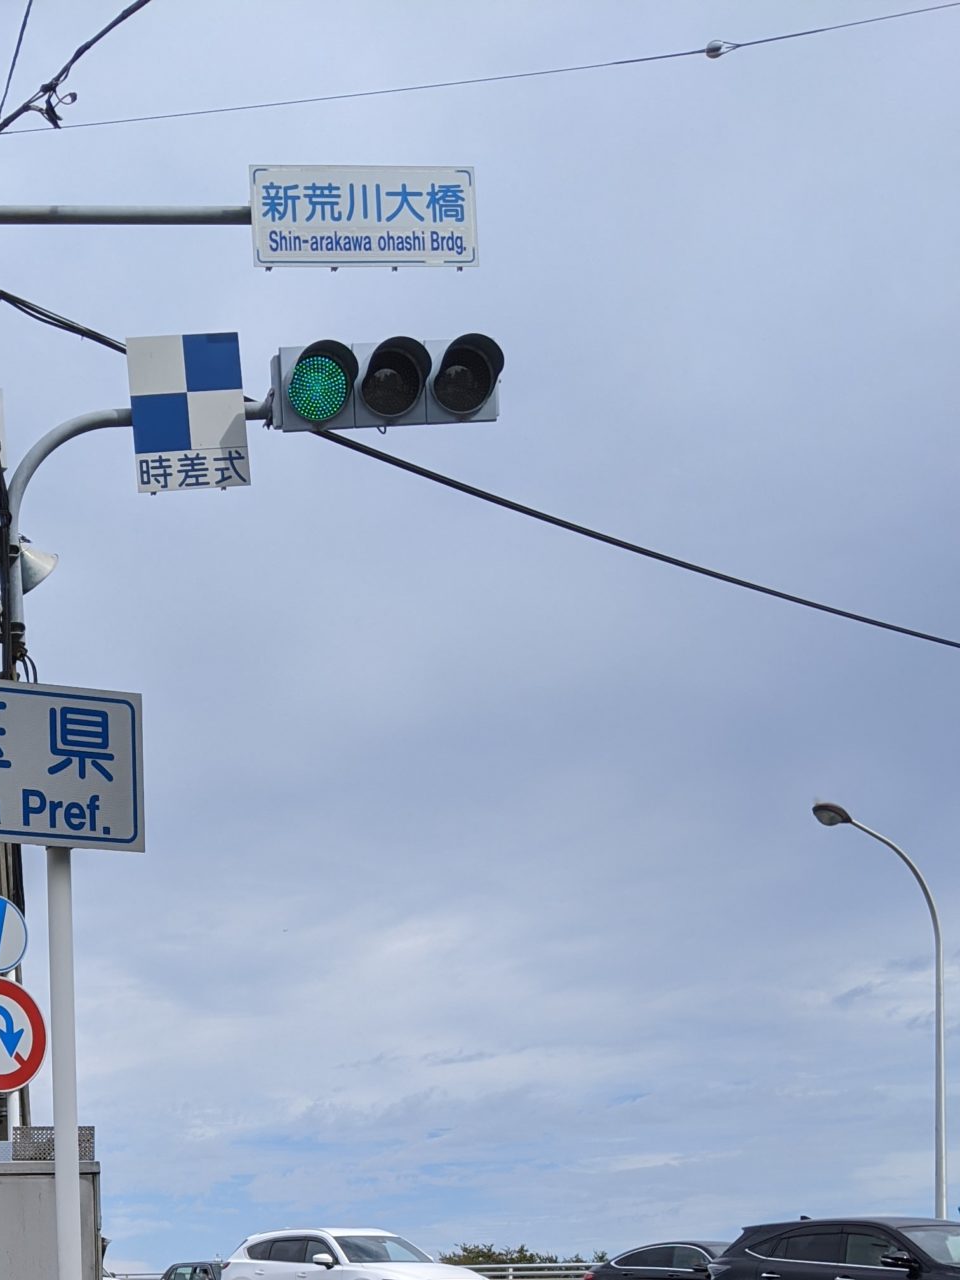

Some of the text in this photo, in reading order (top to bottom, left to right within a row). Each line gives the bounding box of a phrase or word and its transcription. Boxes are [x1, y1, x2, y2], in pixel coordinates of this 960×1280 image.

[262, 182, 466, 223] 新荒川大橋
[269, 230, 467, 255] Shin-arakawa ohashi Brdg.
[138, 449, 248, 489] 時差式
[22, 789, 111, 835] Pref.
